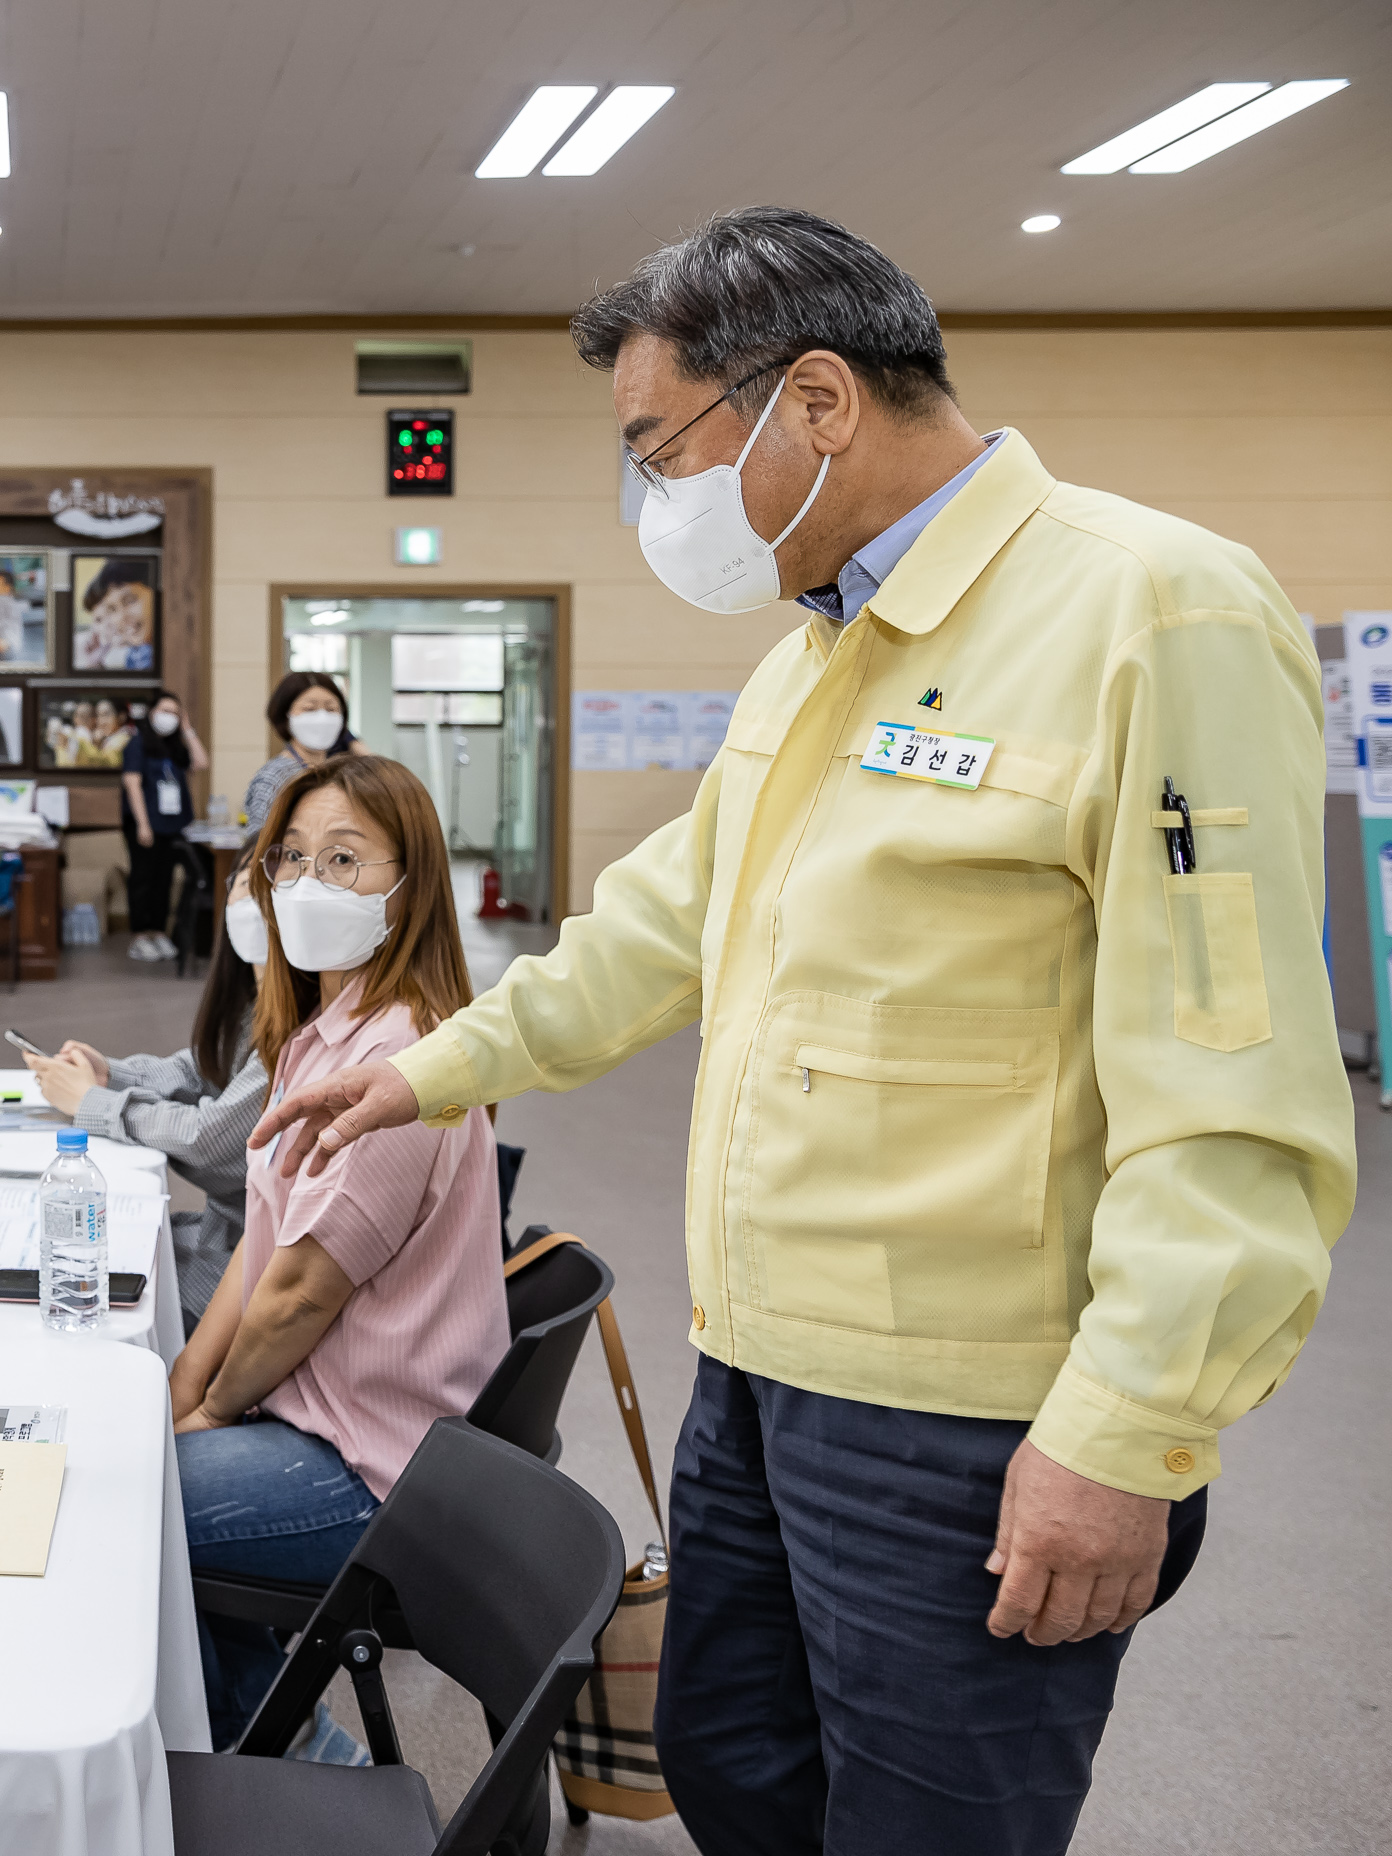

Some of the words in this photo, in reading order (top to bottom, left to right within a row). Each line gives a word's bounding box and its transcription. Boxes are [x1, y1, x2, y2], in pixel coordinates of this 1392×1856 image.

[720, 557, 745, 574] KF-94
[909, 733, 941, 745] 광진구청장
[86, 1203, 96, 1243] water
